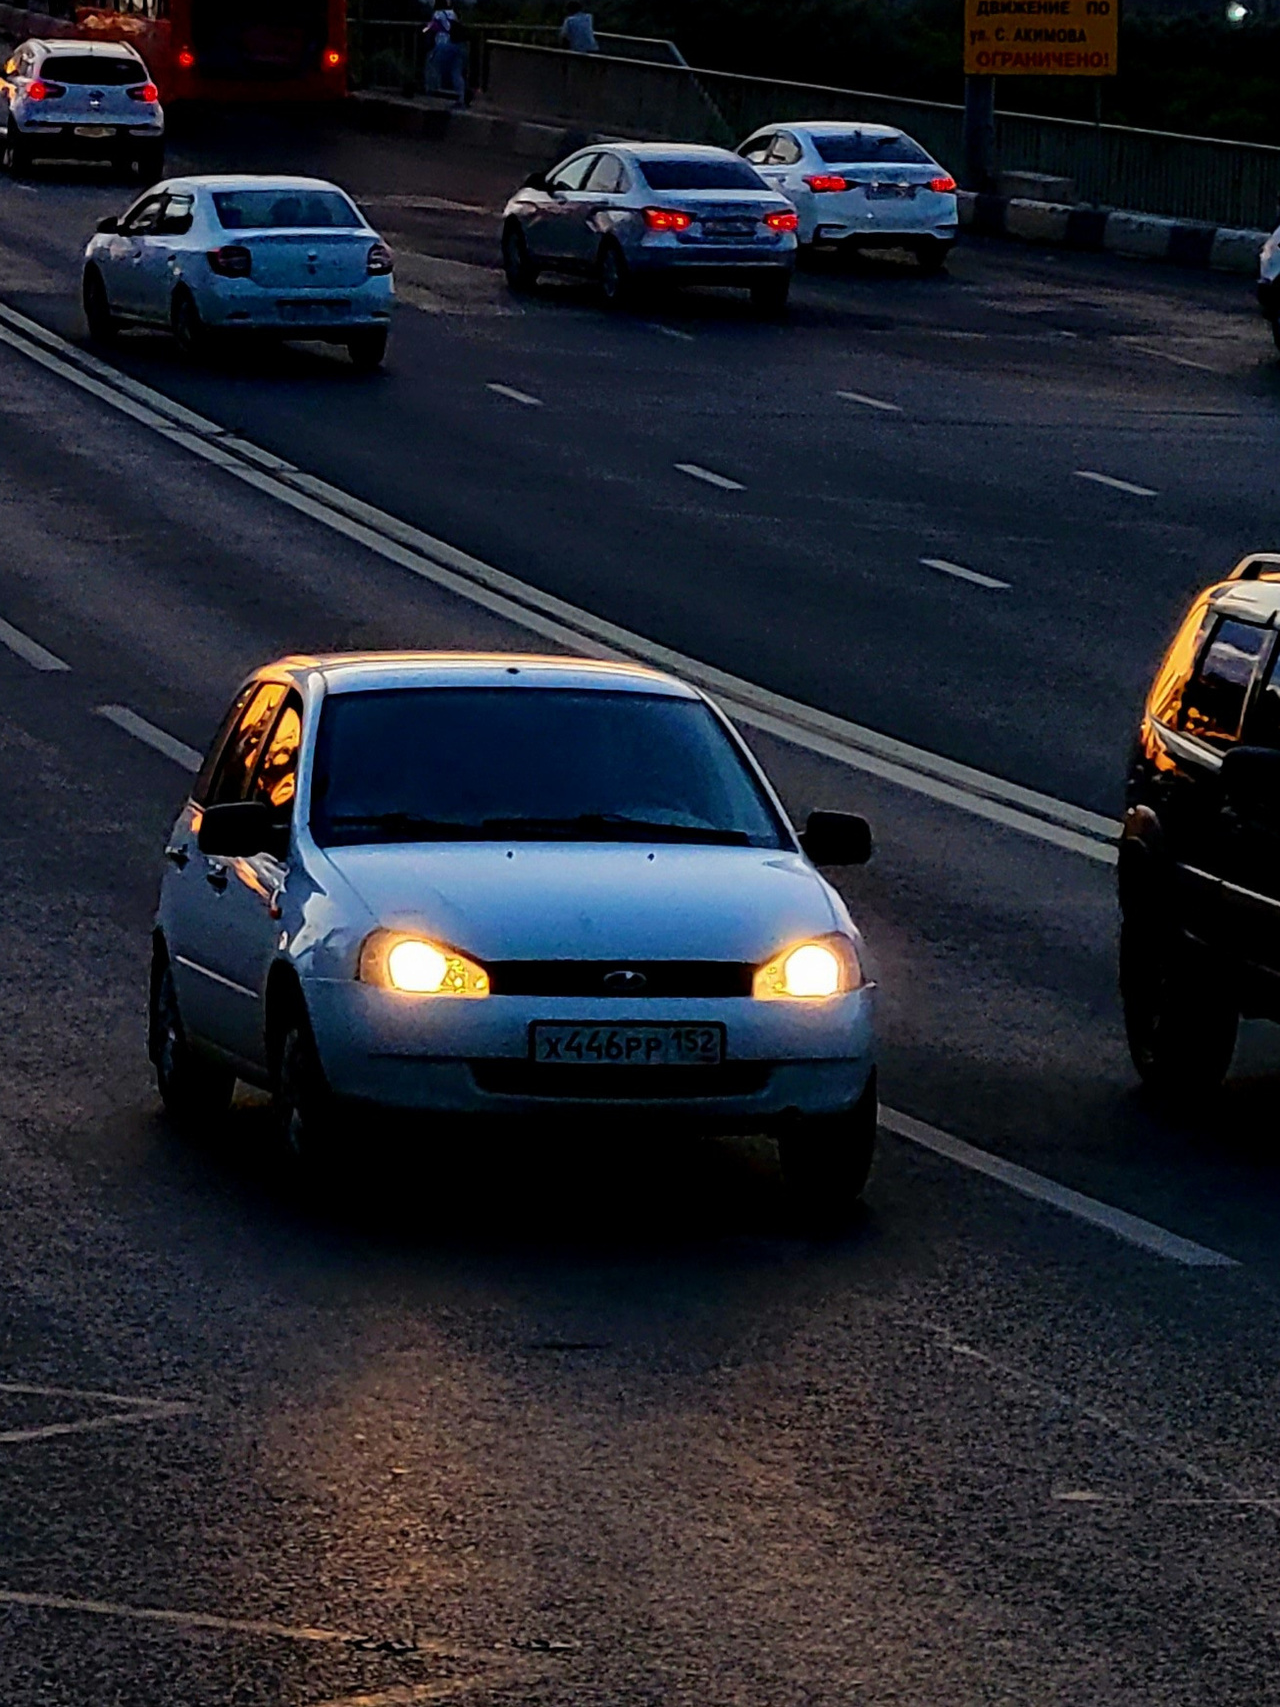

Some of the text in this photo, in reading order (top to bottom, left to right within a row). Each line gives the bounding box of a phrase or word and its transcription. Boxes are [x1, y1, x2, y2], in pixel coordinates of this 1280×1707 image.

[976, 0, 1110, 16] ДВИЖЕНИЕ ПО
[1013, 28, 1087, 43] АКИМОВА
[975, 51, 1110, 68] ОГРАНИЧЕНО!
